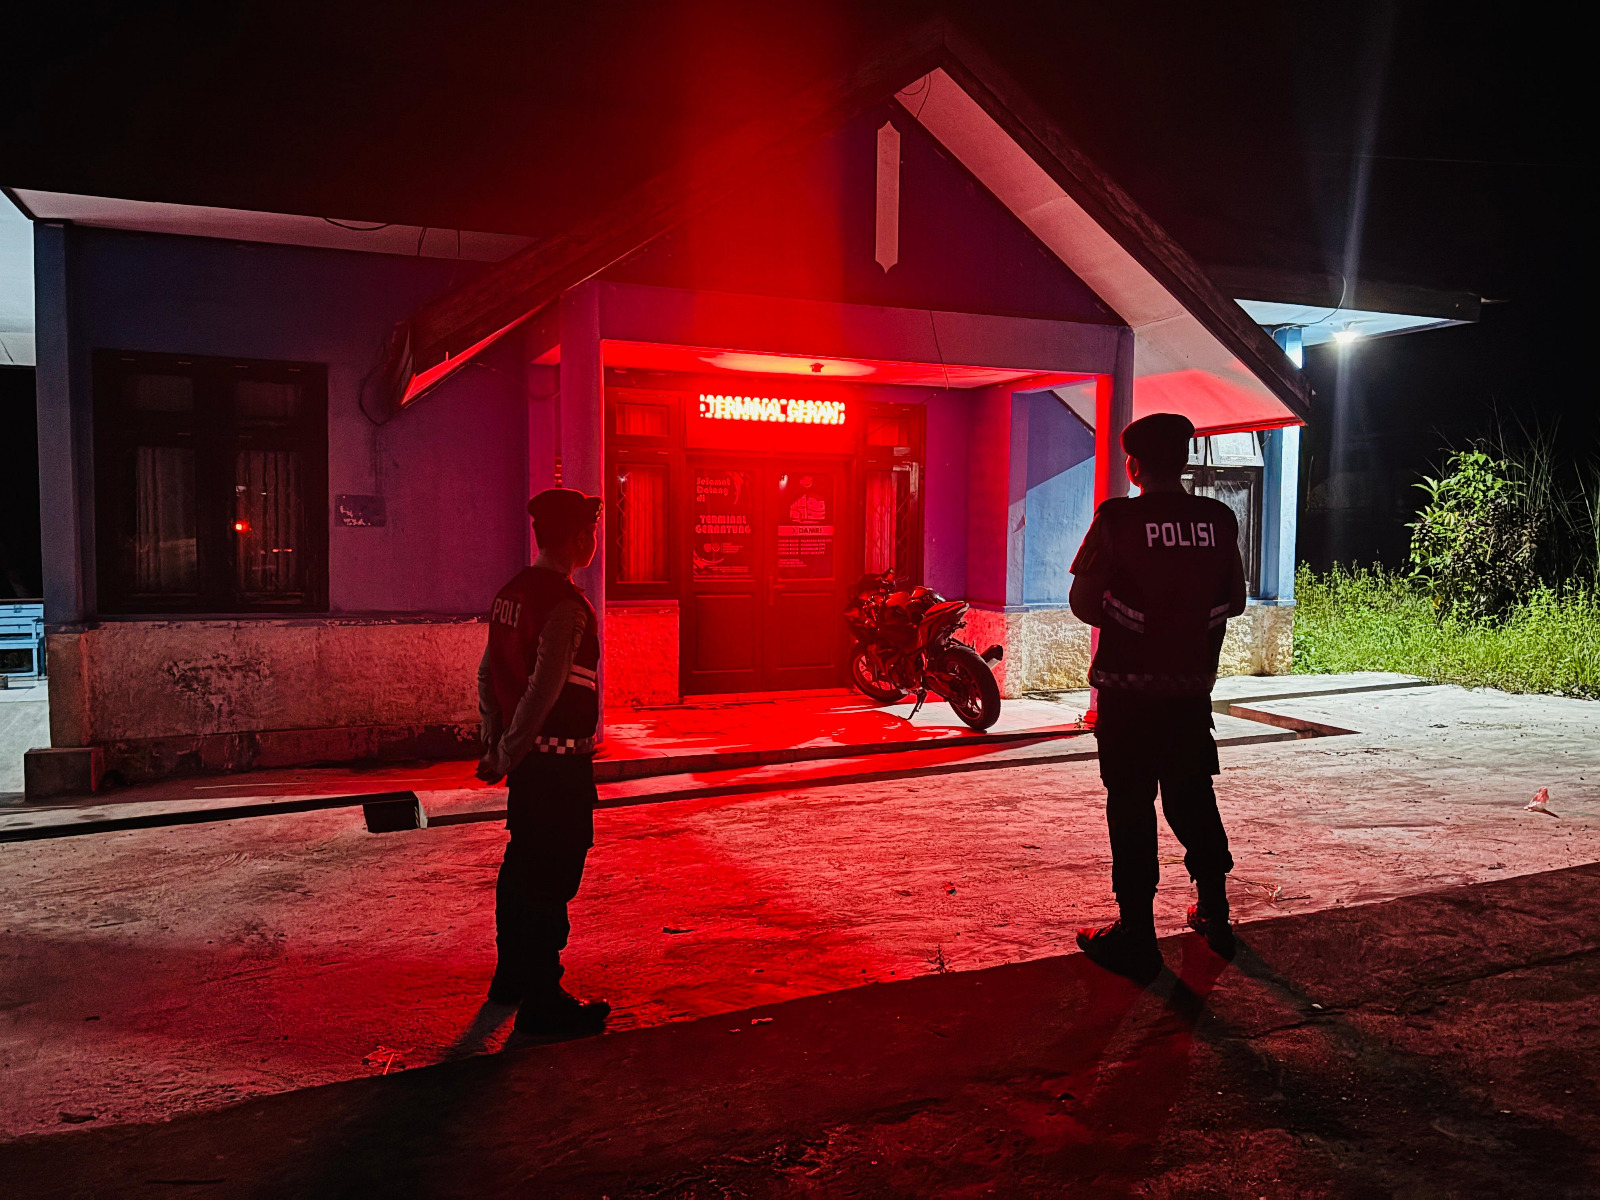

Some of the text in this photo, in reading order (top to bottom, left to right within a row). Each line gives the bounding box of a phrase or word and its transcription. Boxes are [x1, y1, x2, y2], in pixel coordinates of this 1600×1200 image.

[704, 397, 785, 418] TERMINAL
[696, 477, 731, 486] Selamat
[696, 486, 729, 496] Datang
[1145, 522, 1216, 547] POLISI
